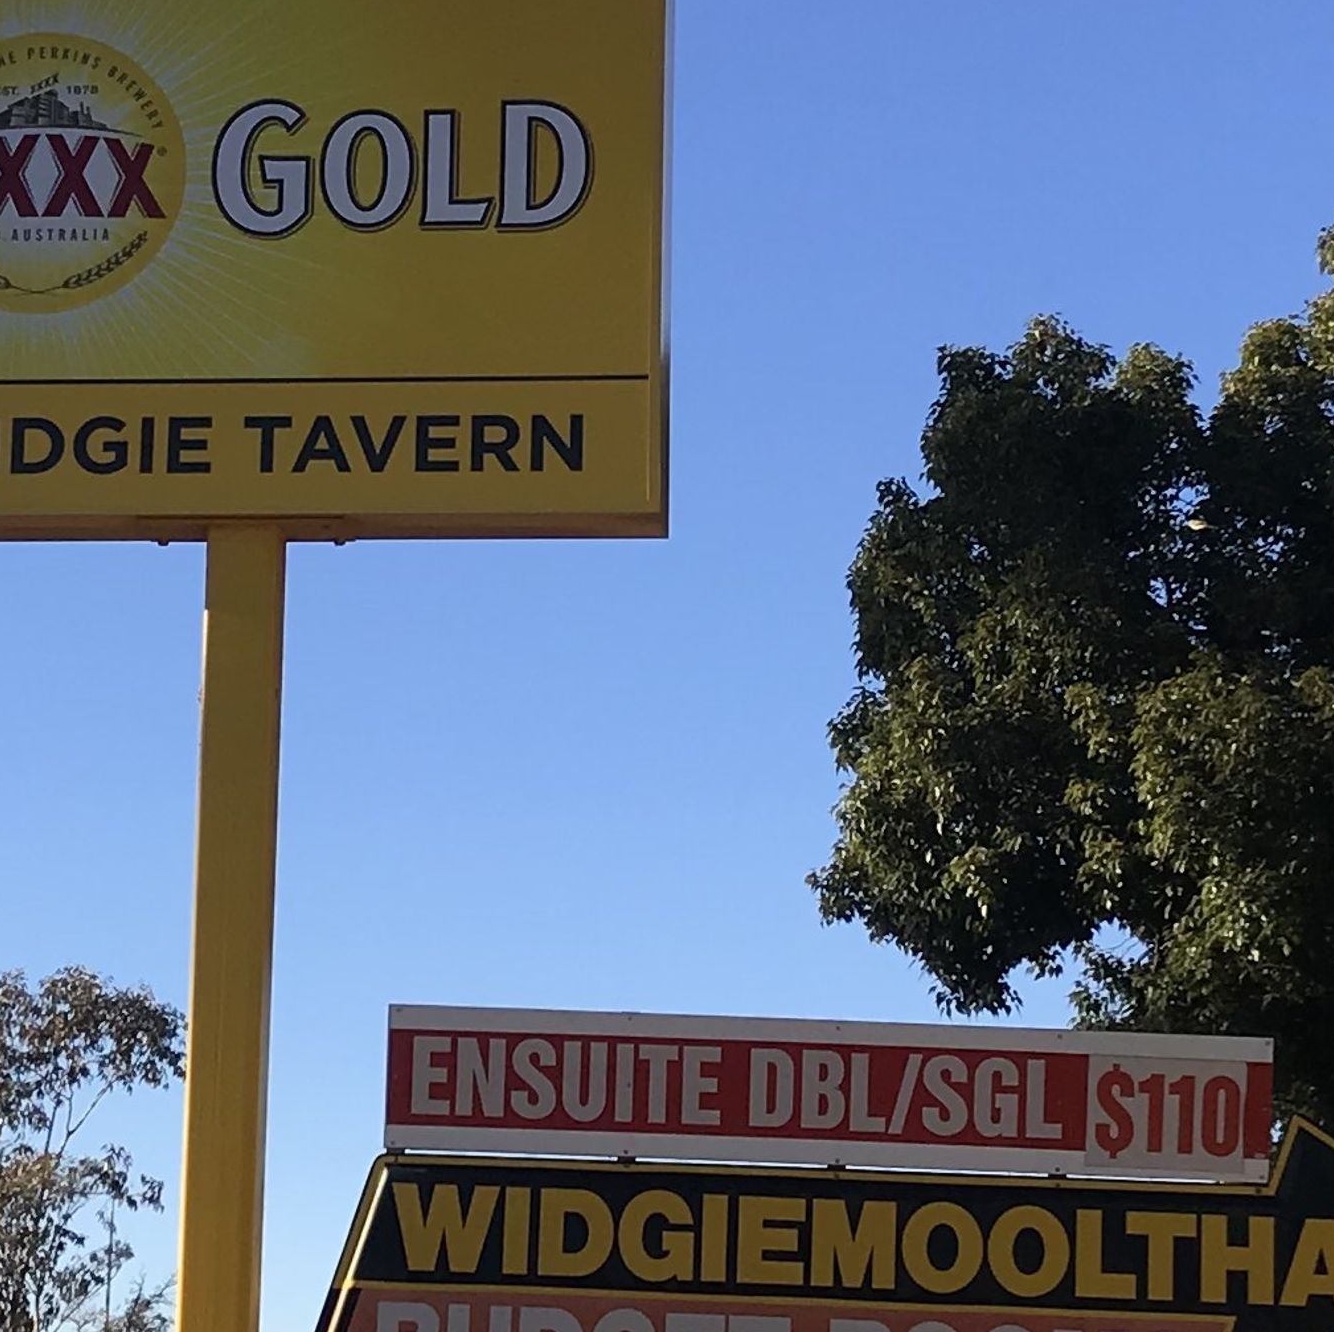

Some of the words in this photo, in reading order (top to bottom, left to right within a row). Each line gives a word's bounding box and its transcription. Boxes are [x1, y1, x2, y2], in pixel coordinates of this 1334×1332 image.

[27, 46, 102, 70] PERKINS
[107, 65, 164, 129] BREWERY
[212, 99, 593, 238] GOLD
[11, 228, 110, 242] AUSTRALIA
[244, 414, 585, 474] TAVERN
[410, 1035, 722, 1126] ENSUITE
[748, 1047, 1063, 1139] DBL/SGL
[1095, 1064, 1241, 1159] $110
